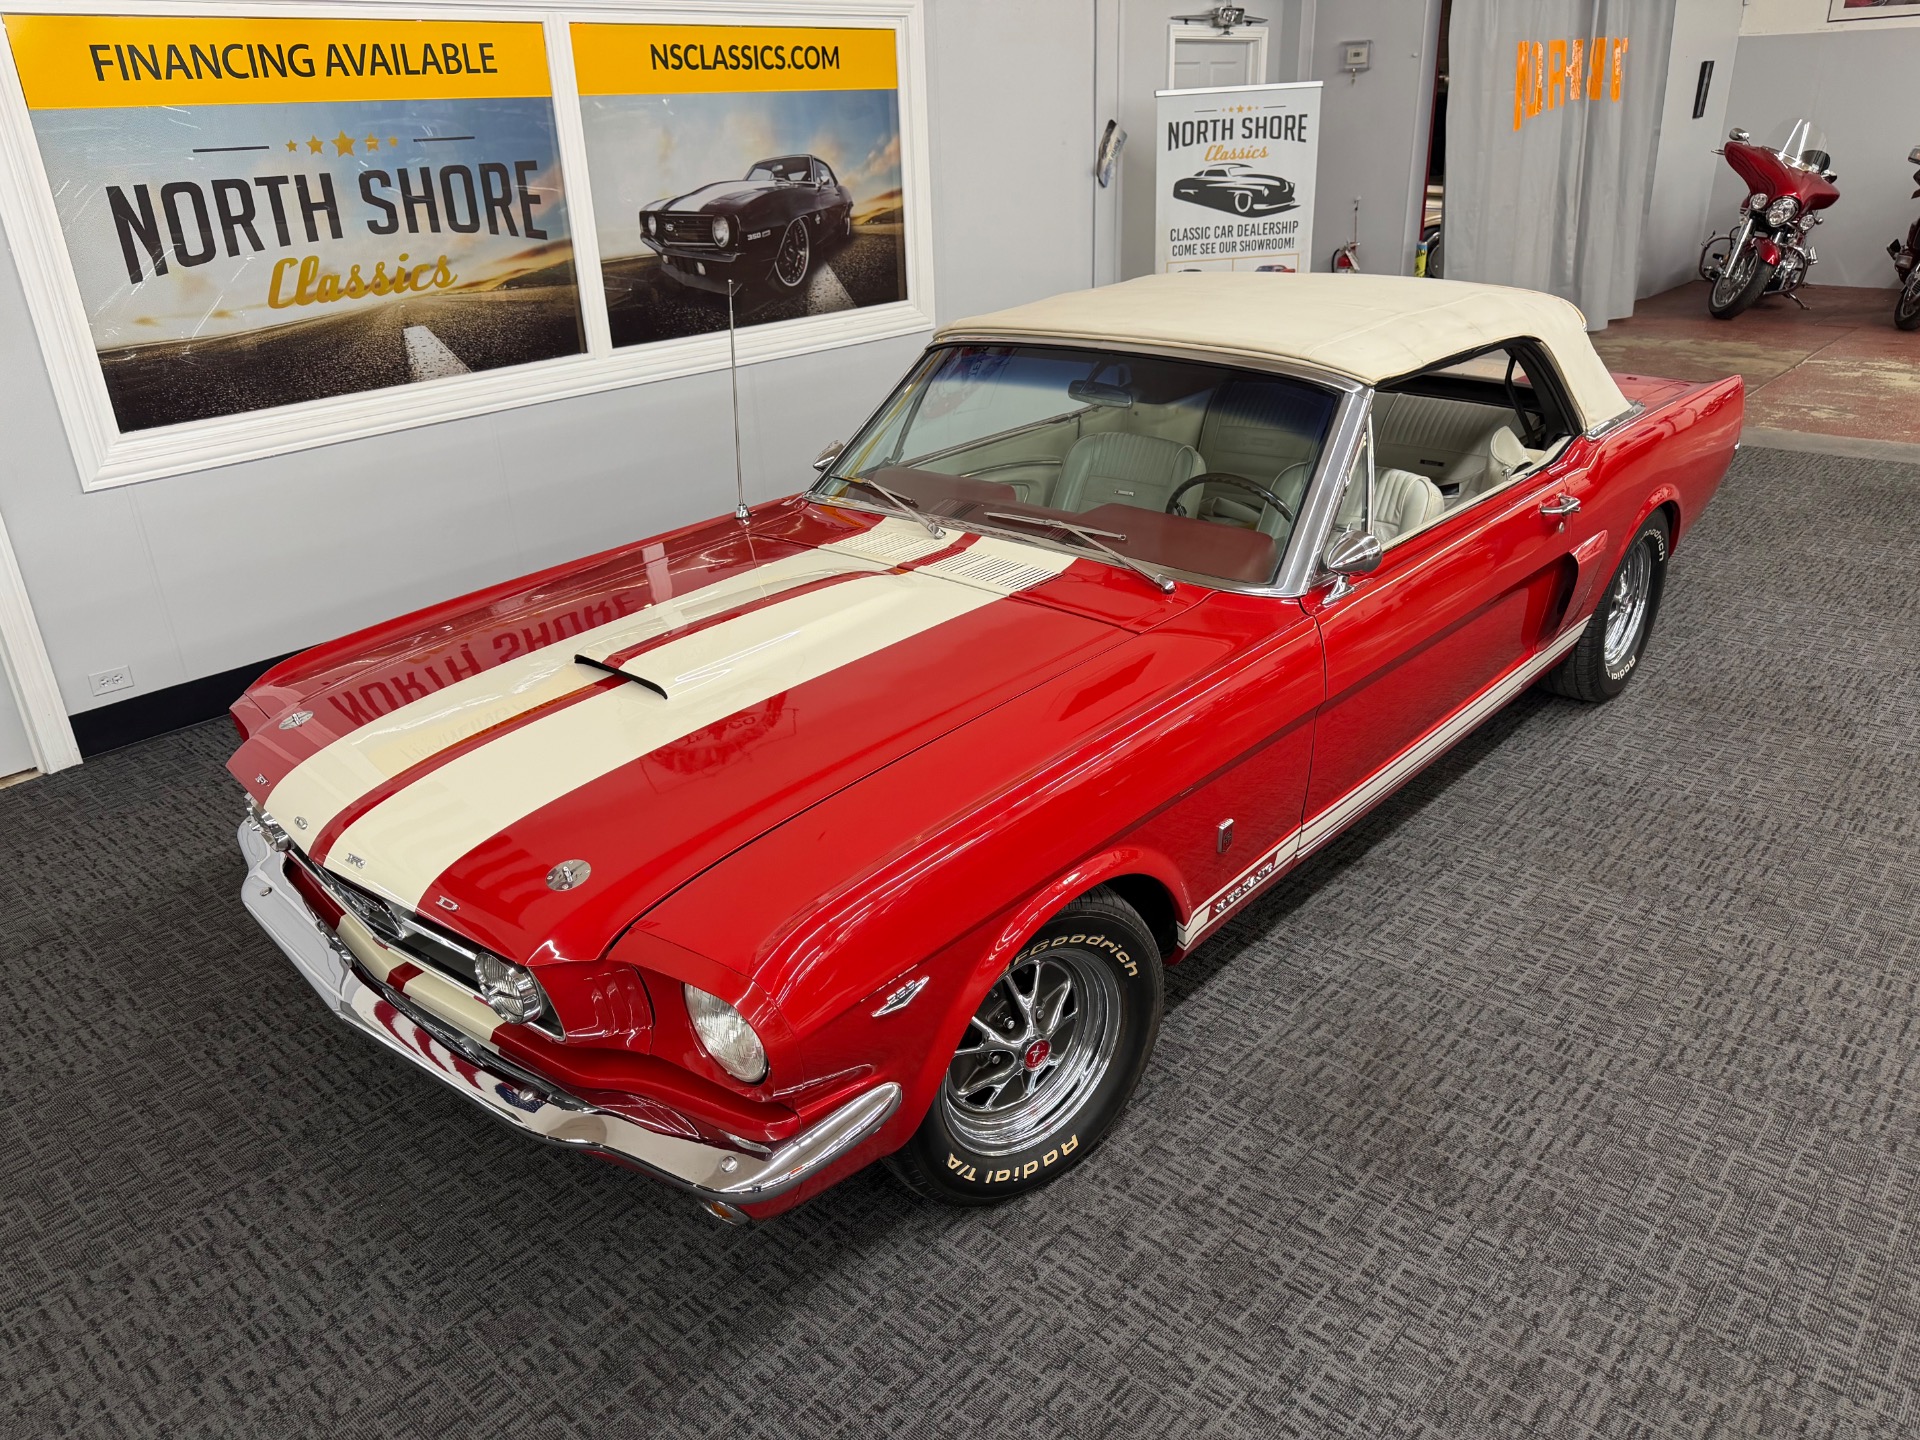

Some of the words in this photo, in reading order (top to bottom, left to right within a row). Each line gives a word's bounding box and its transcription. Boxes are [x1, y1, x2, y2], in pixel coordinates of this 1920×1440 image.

[89, 44, 315, 81] FINANCING
[325, 43, 497, 77] AVAILABLE
[650, 44, 840, 70] NSCLASSICS.COM
[1167, 118, 1234, 151] NORTH
[1241, 114, 1308, 143] SHORE
[1204, 145, 1269, 162] Classics
[107, 172, 344, 284] NORTH
[358, 160, 548, 240] SHORE
[1170, 226, 1211, 242] CLASSIC
[1214, 225, 1234, 239] CAR
[1237, 220, 1299, 238] DEALERSHIP
[1172, 243, 1198, 257] COME
[1200, 242, 1216, 255] SEE
[1219, 241, 1237, 253] OUR
[1240, 237, 1295, 252] SHOWROOM!
[268, 253, 457, 310] Classics
[1611, 655, 1636, 680] Radial
[1003, 933, 1139, 977] FGoodrich
[947, 1152, 977, 1182] T/A
[985, 1134, 1079, 1184] Radial
